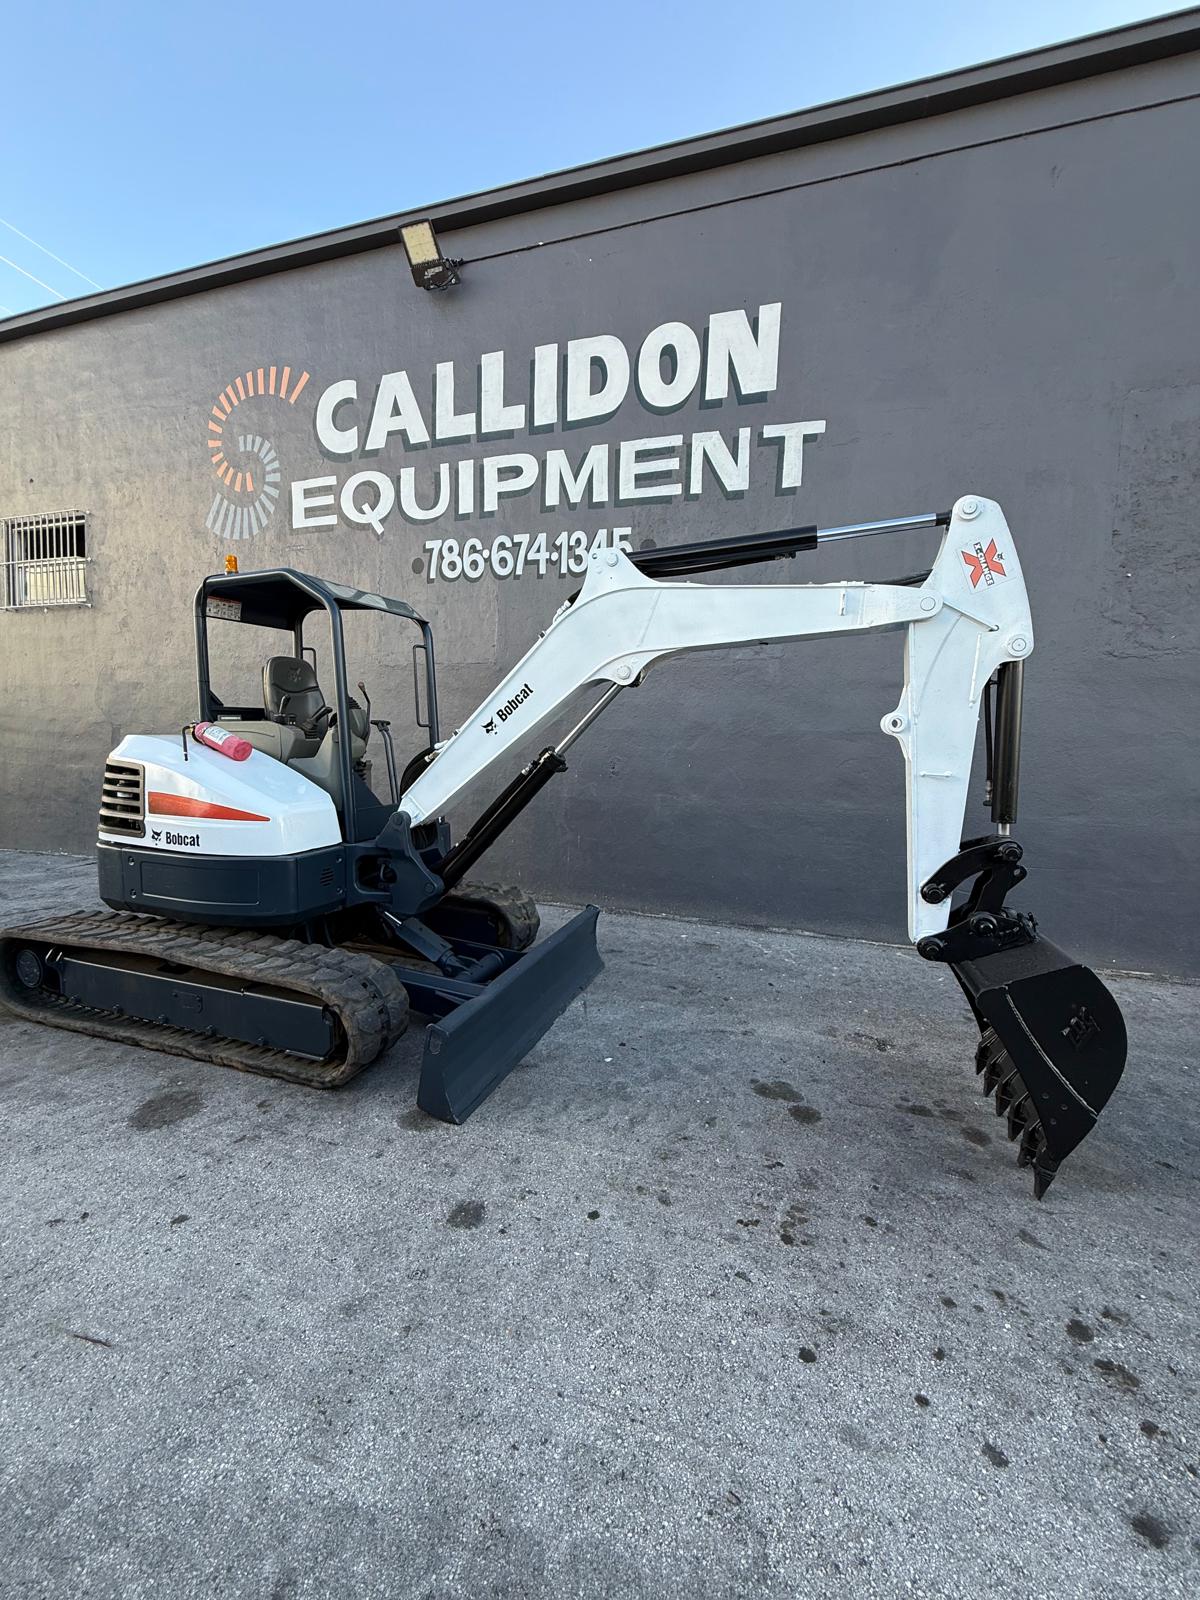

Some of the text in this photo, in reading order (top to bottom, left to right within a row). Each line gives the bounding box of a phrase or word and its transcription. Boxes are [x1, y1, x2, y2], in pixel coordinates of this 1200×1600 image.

[316, 302, 782, 454] CALLIDON
[291, 420, 826, 535] EQUIPMENT
[496, 683, 534, 722] Bobcat
[165, 831, 201, 847] Bobcat
